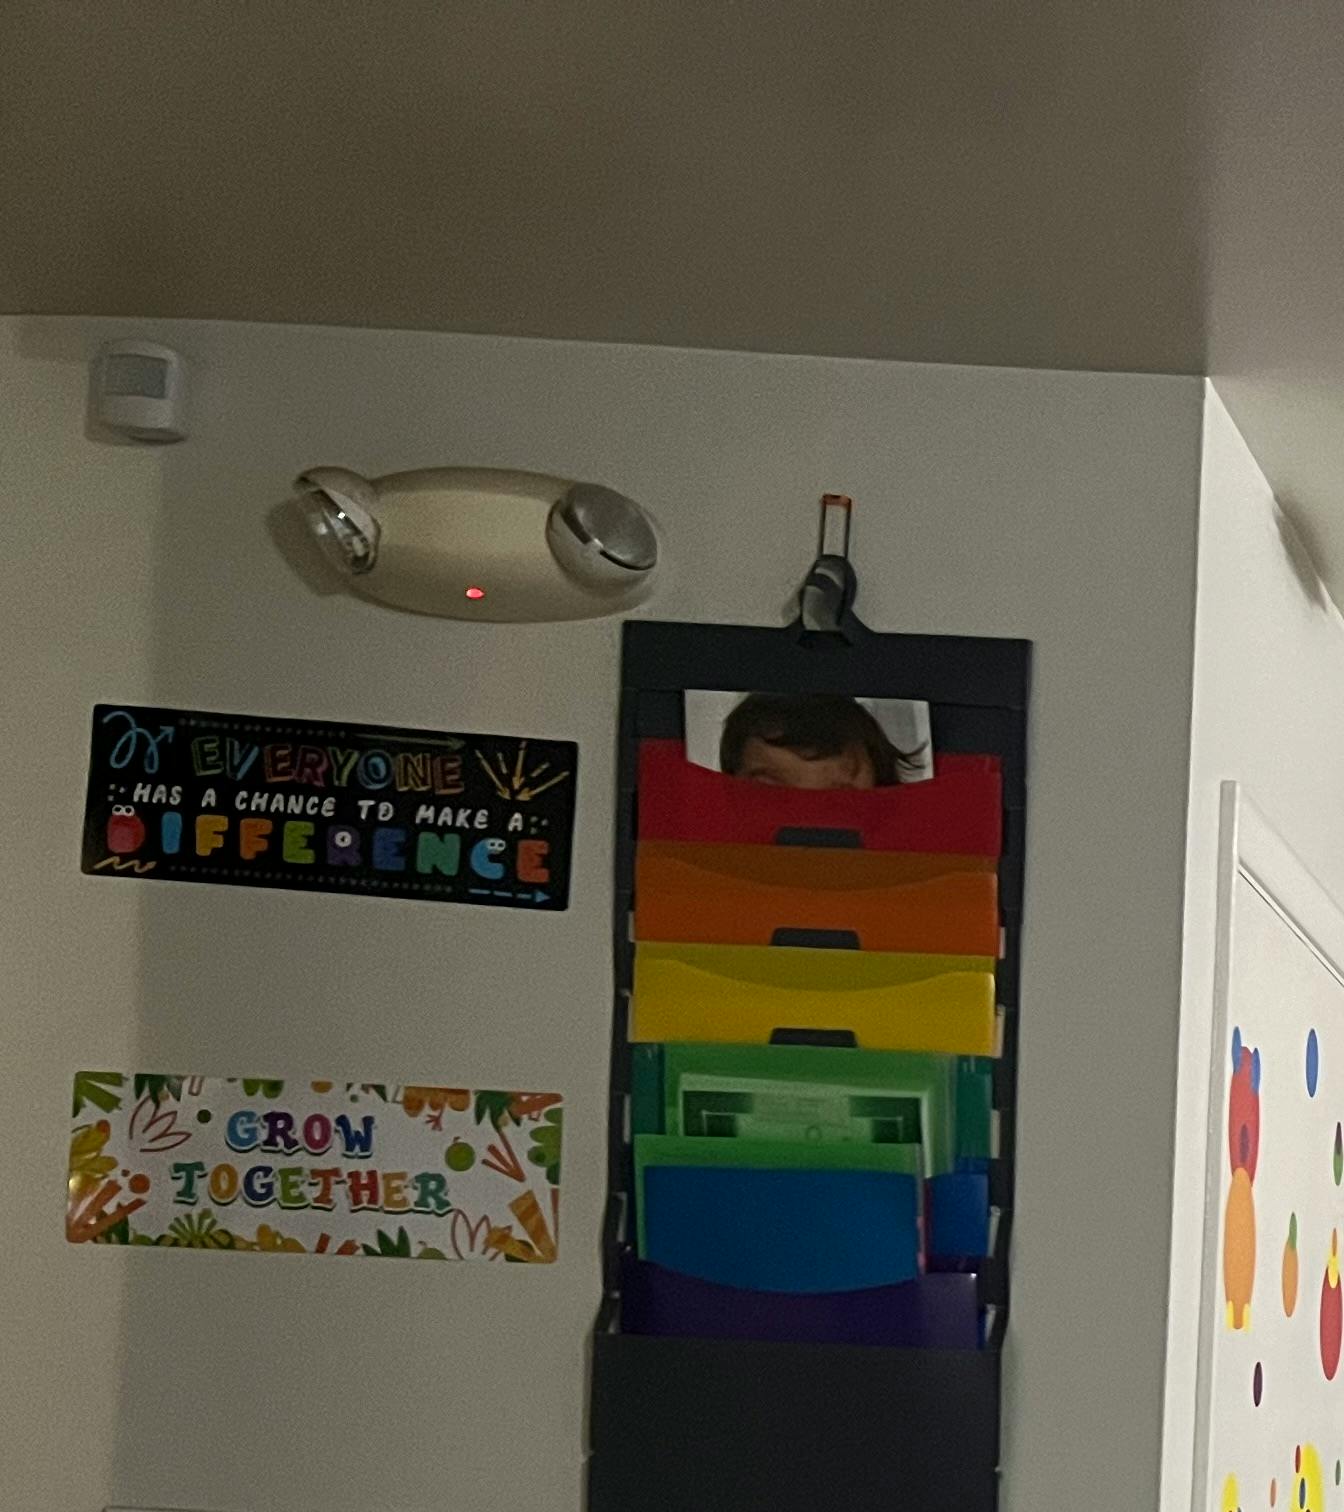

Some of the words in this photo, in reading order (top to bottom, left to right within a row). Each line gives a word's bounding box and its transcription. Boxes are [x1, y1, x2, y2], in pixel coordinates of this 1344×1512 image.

[190, 736, 465, 795] EVERYONE
[133, 782, 182, 805] HAS
[200, 787, 217, 808] A
[234, 790, 336, 818] CHANCE
[357, 800, 394, 822] TO
[415, 804, 489, 830] MAKE
[507, 812, 524, 832] A
[107, 811, 551, 884] DIFFERENCE
[225, 1109, 375, 1158] GROW
[172, 1162, 452, 1215] TOGETHER
